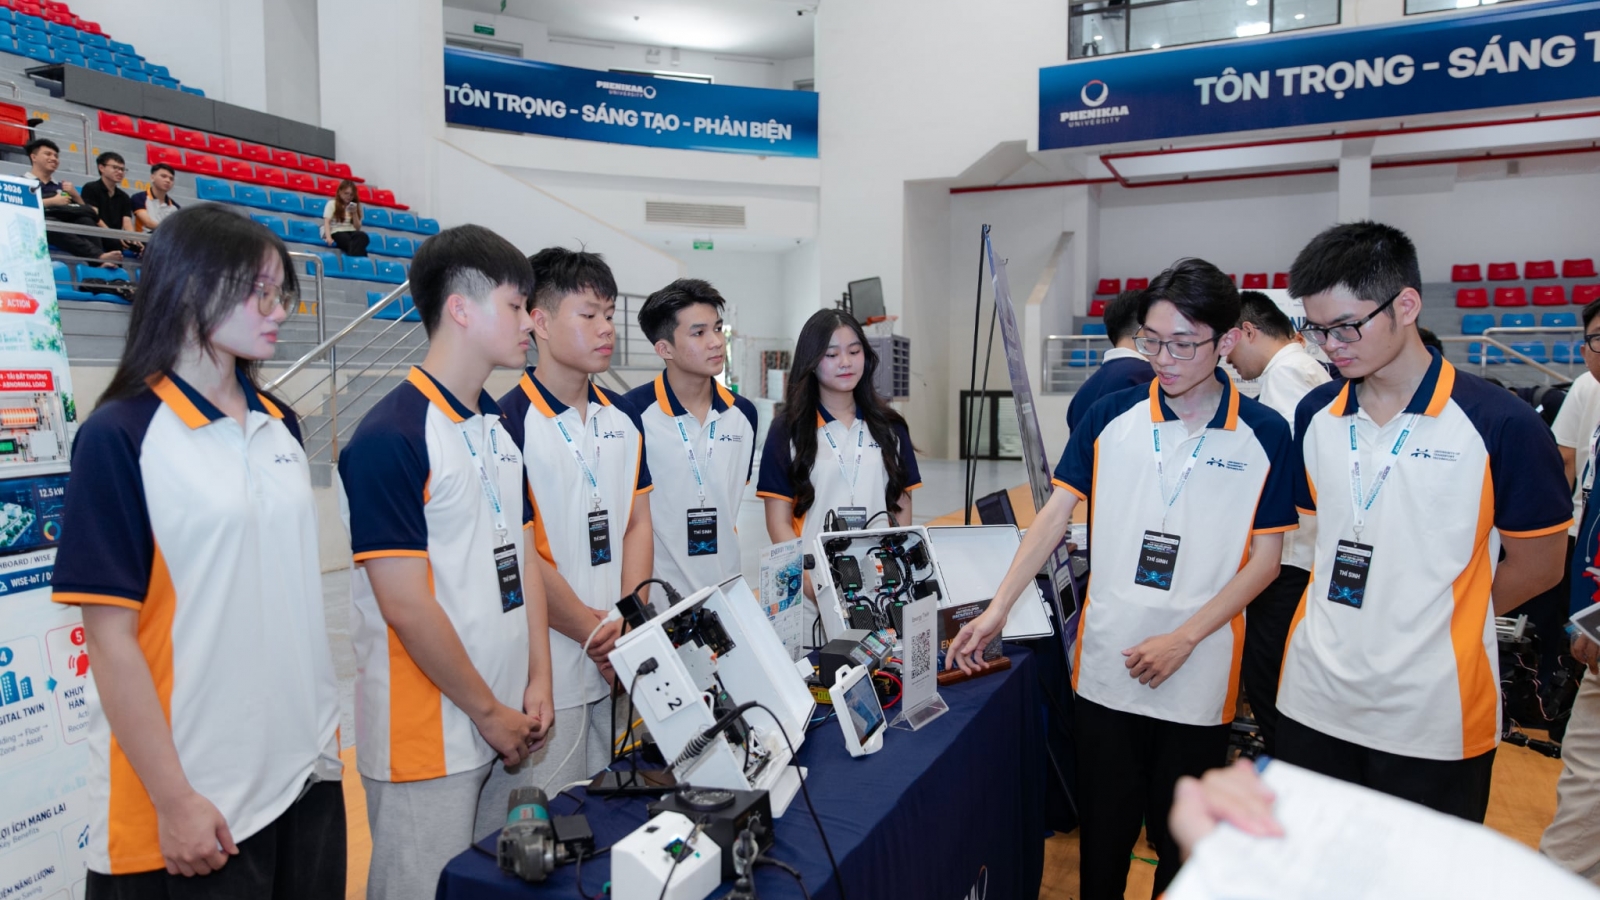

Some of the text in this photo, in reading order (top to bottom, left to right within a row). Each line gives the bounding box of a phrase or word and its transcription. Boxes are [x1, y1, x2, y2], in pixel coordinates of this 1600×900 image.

[1194, 67, 1269, 105] TÔN
[1276, 55, 1415, 99] TRỌNG
[1447, 35, 1576, 79] SÁNG
[596, 80, 644, 93] PHENIKAA
[609, 89, 643, 98] UNIVERSITY
[444, 82, 490, 109] TÔN
[493, 92, 567, 119] TRỌNG
[581, 102, 638, 127] SÁNG
[640, 111, 680, 134] TẠO
[694, 114, 748, 138] PHẢN
[750, 118, 792, 144] BIỆN
[1060, 105, 1129, 122] PHENIKAA
[1068, 117, 1120, 128] UNIVERSITY
[4, 193, 23, 205] TWIN
[7, 299, 31, 309] ACTION
[39, 487, 54, 498] 12.5
[34, 554, 51, 563] WISE
[1348, 571, 1361, 579] SINH
[75, 631, 83, 643] 5
[23, 702, 45, 717] TWIN
[668, 697, 683, 711] 2
[28, 809, 52, 826] MANG
